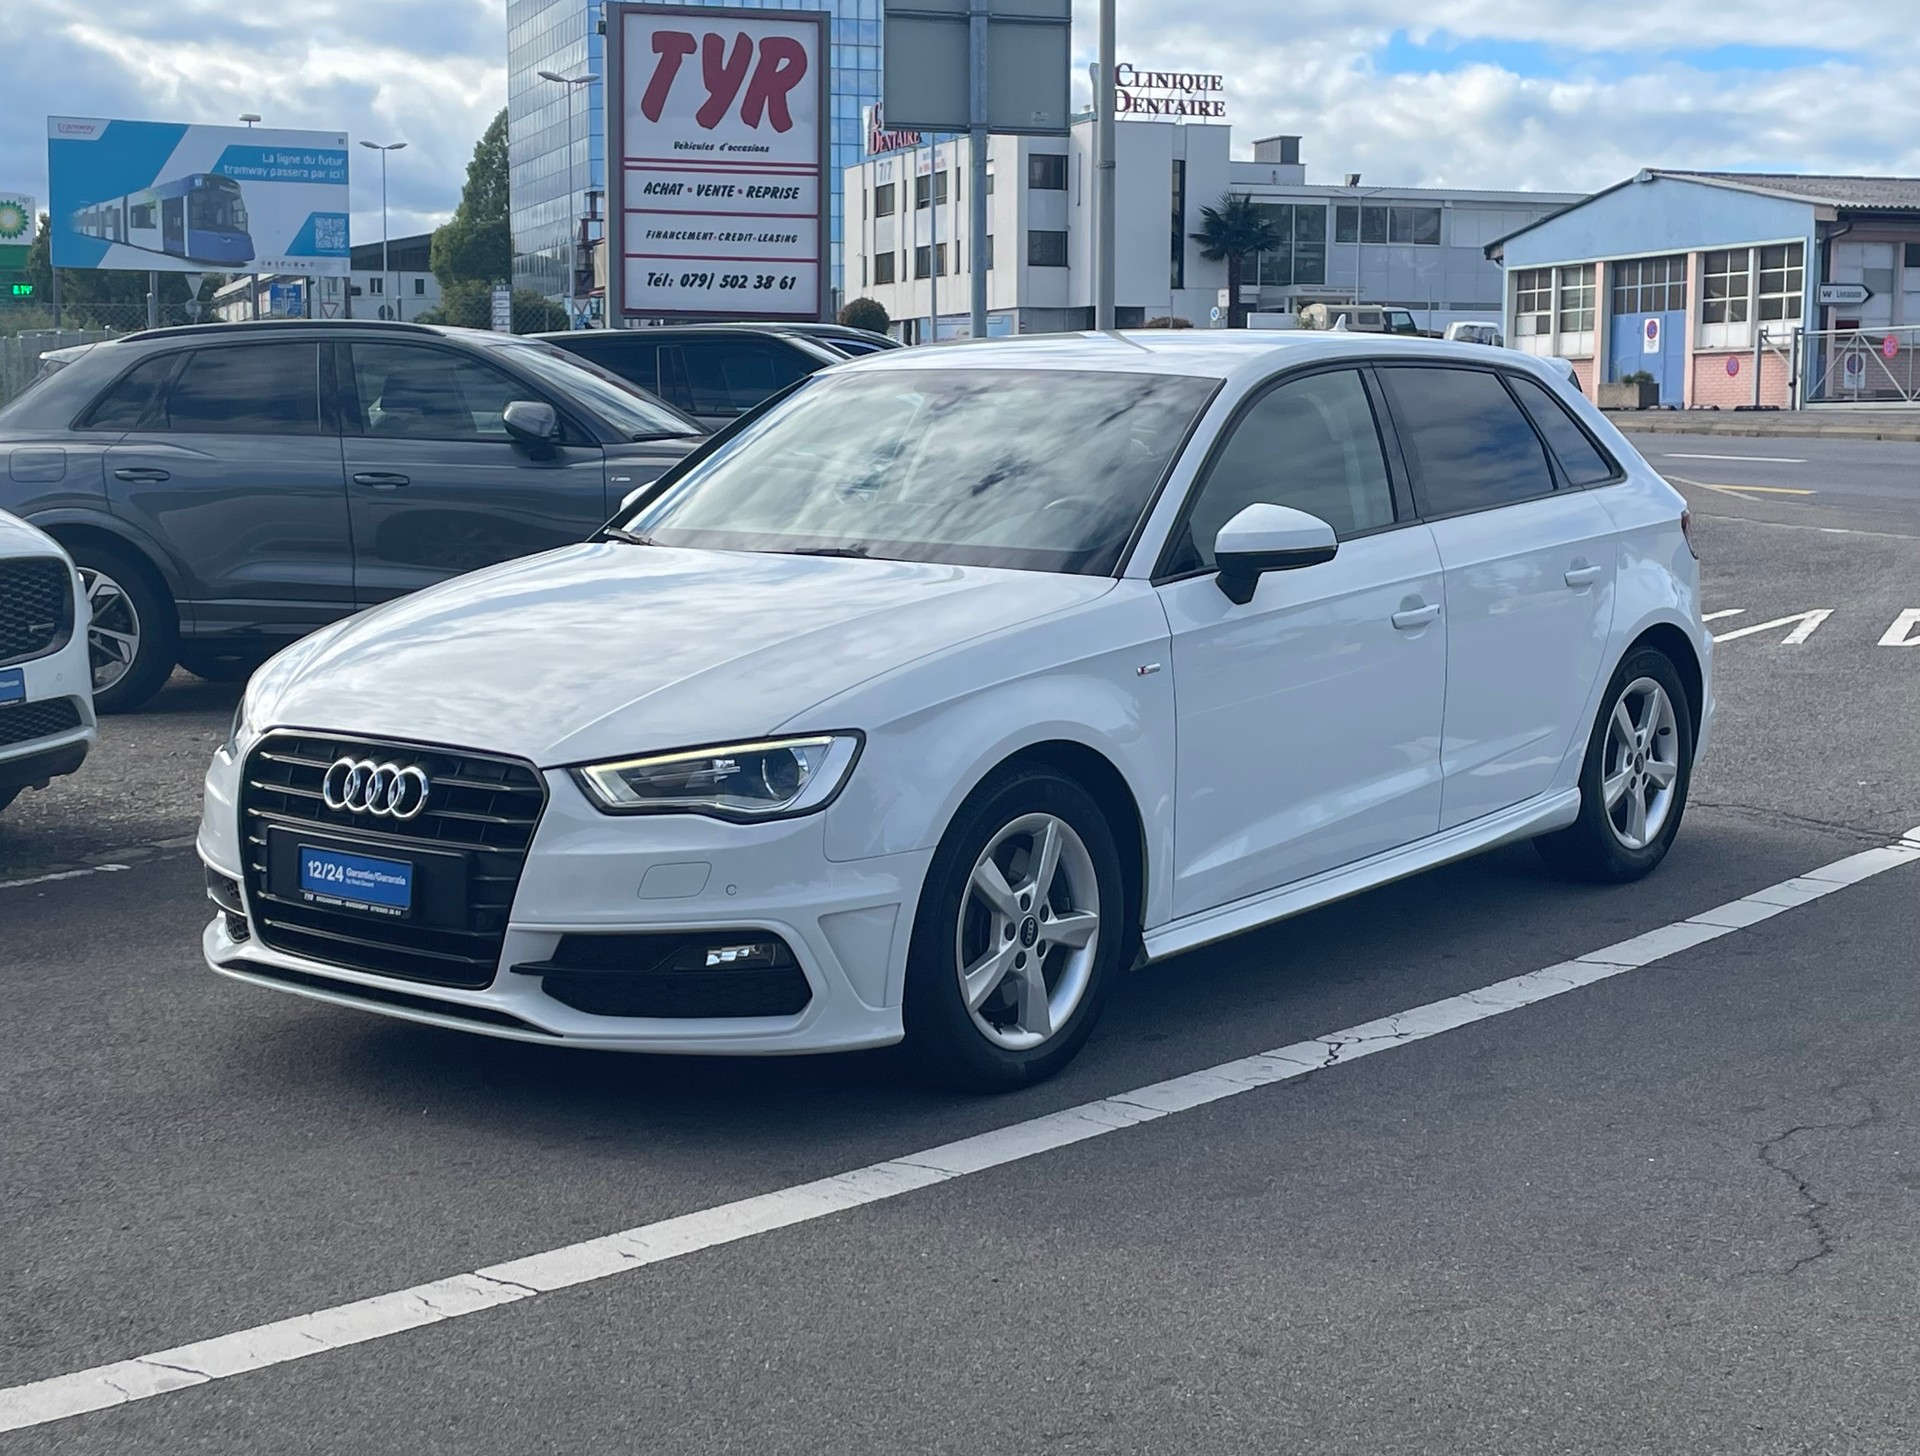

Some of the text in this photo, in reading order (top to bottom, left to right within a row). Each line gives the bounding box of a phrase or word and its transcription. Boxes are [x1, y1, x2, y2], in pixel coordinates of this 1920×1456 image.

[641, 31, 807, 133] TYR
[1115, 63, 1223, 94] CLINIQUE
[1115, 89, 1225, 117] DENTAIRE
[719, 142, 770, 153] d'occasions
[262, 153, 344, 166] La ligne du futur
[223, 164, 267, 177] tramway
[270, 167, 308, 178] passera
[311, 170, 327, 180] par
[643, 181, 800, 200] ACHAT VENTE REPRISE
[645, 229, 799, 244] FINANCEMENT CREDIT LEASING
[647, 272, 674, 288] Tél:
[719, 274, 748, 289] 502
[753, 275, 775, 290] 38
[779, 275, 797, 290] 61
[308, 860, 344, 883] 12/24
